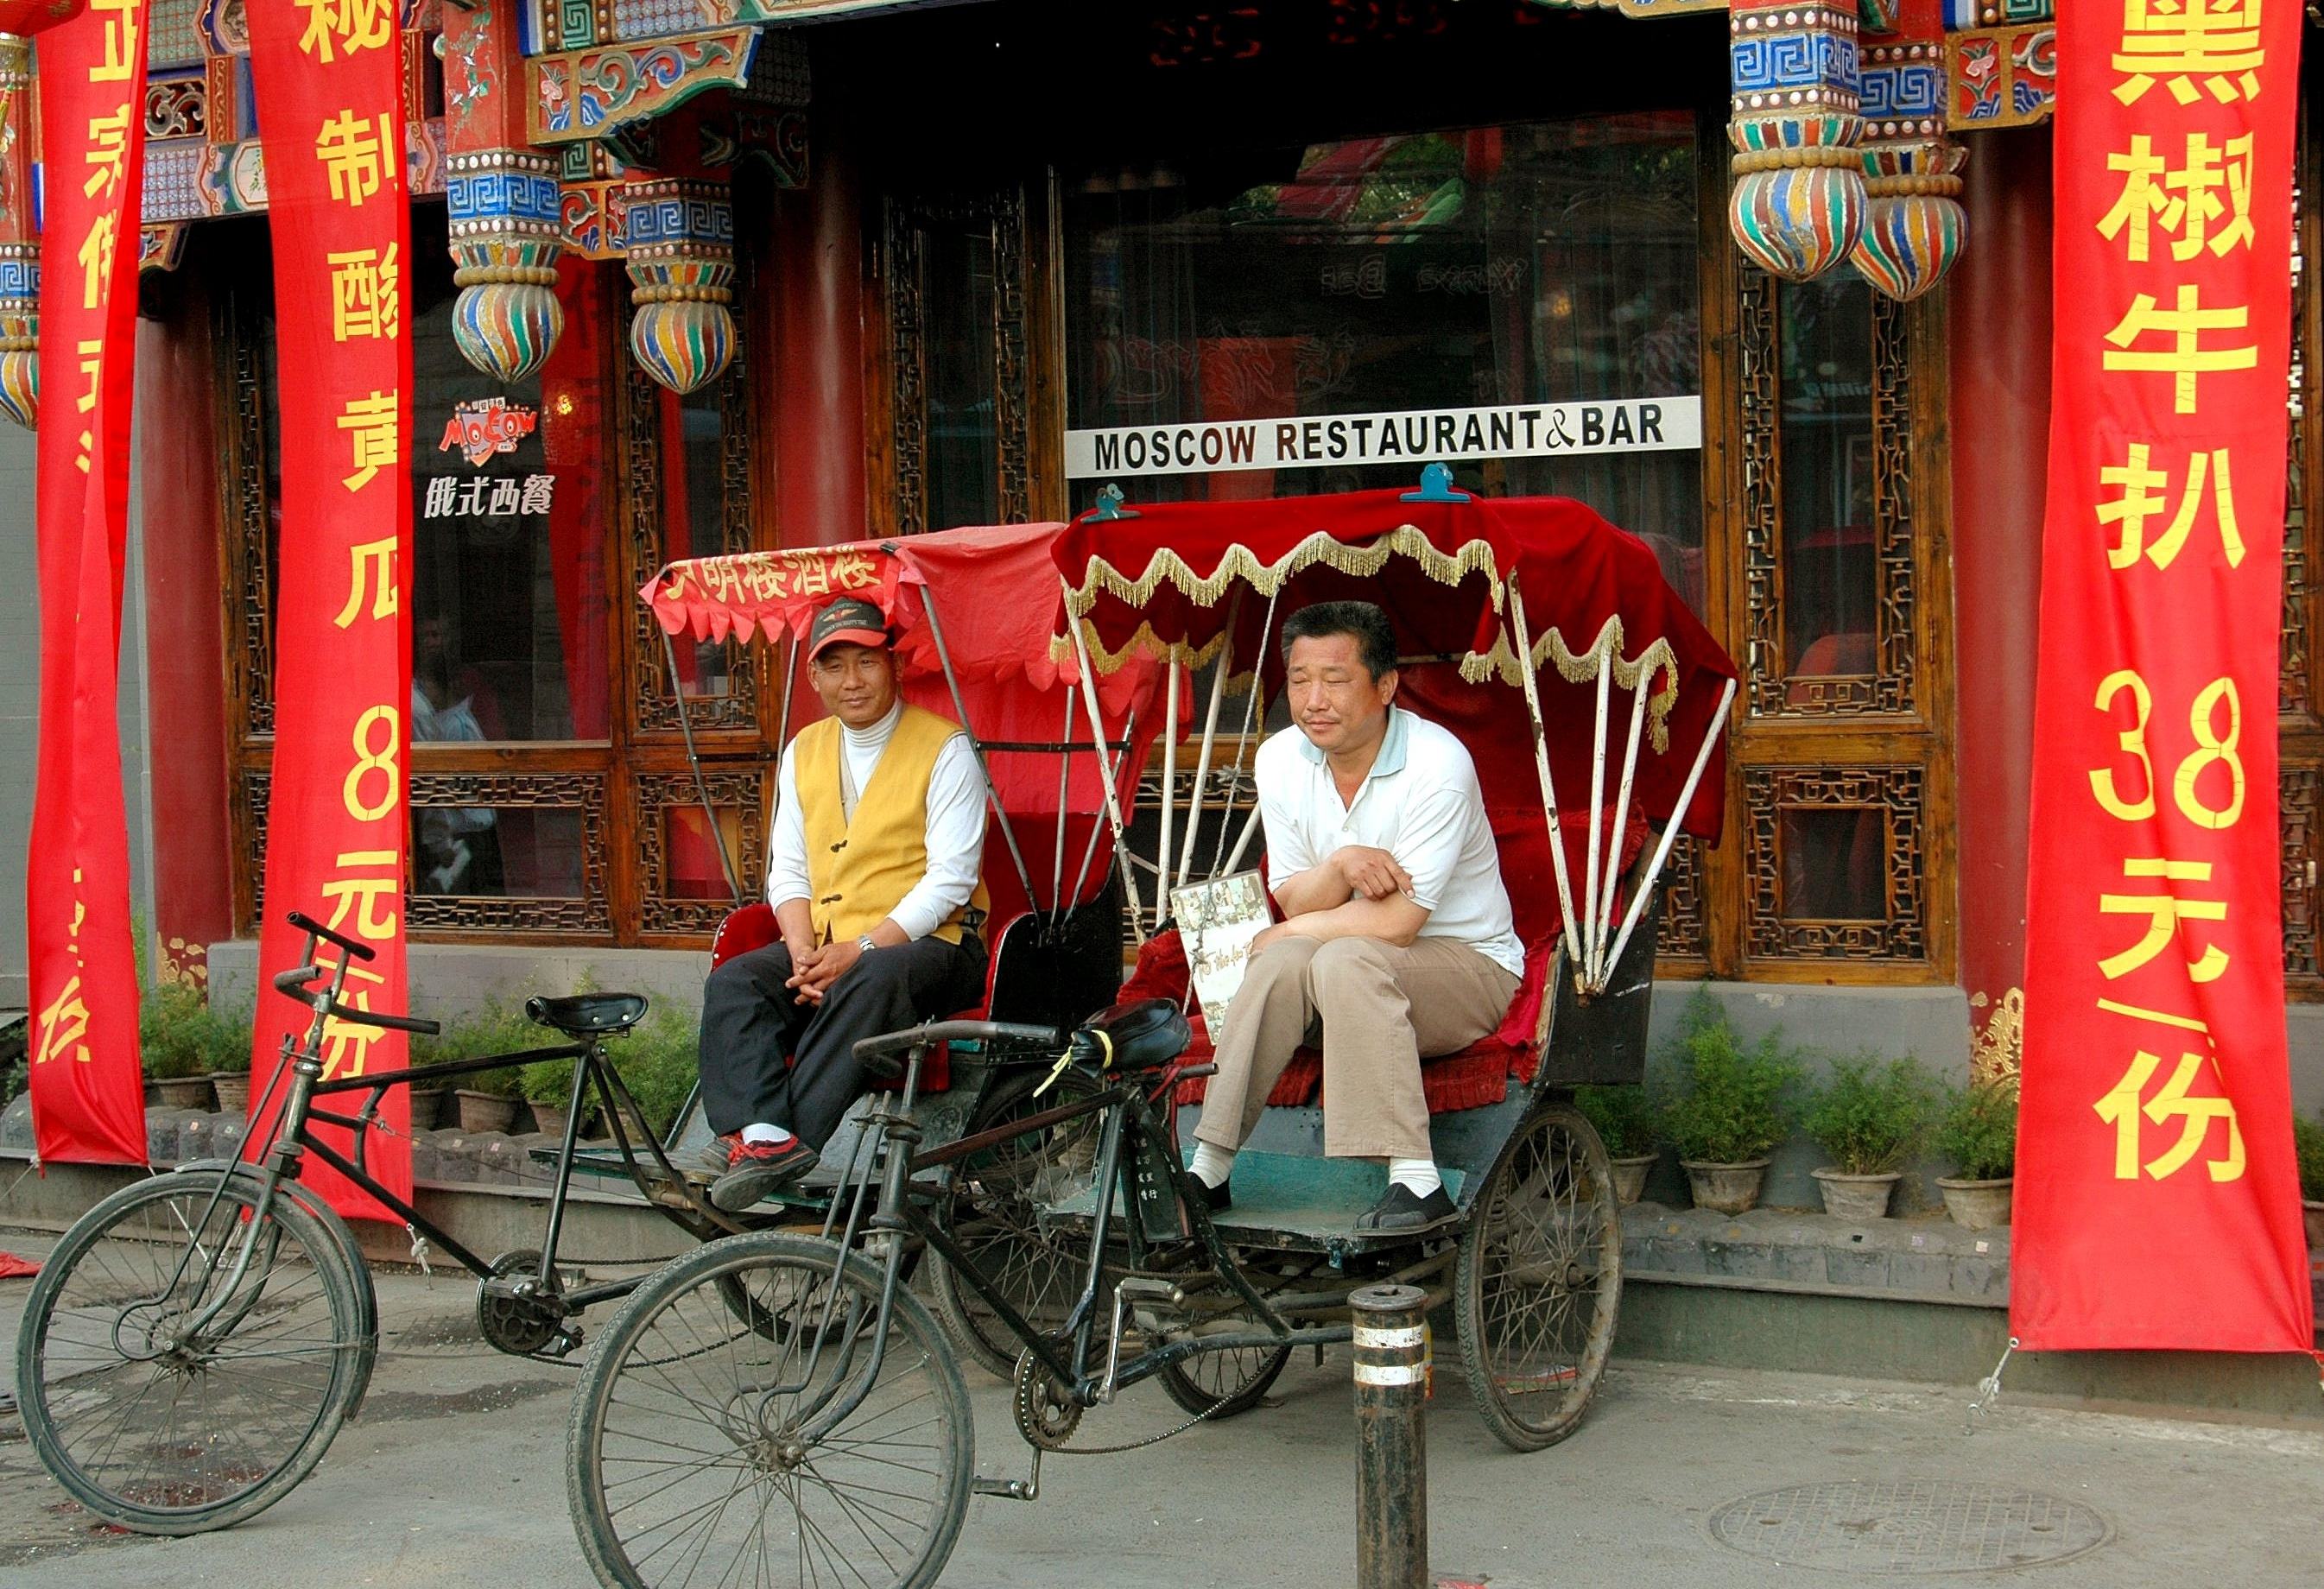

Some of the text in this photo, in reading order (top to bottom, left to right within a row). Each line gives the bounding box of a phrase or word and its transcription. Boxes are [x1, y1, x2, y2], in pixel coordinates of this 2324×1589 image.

[1094, 426, 1257, 471] MOSCOW
[424, 474, 555, 518] 俄式西餐
